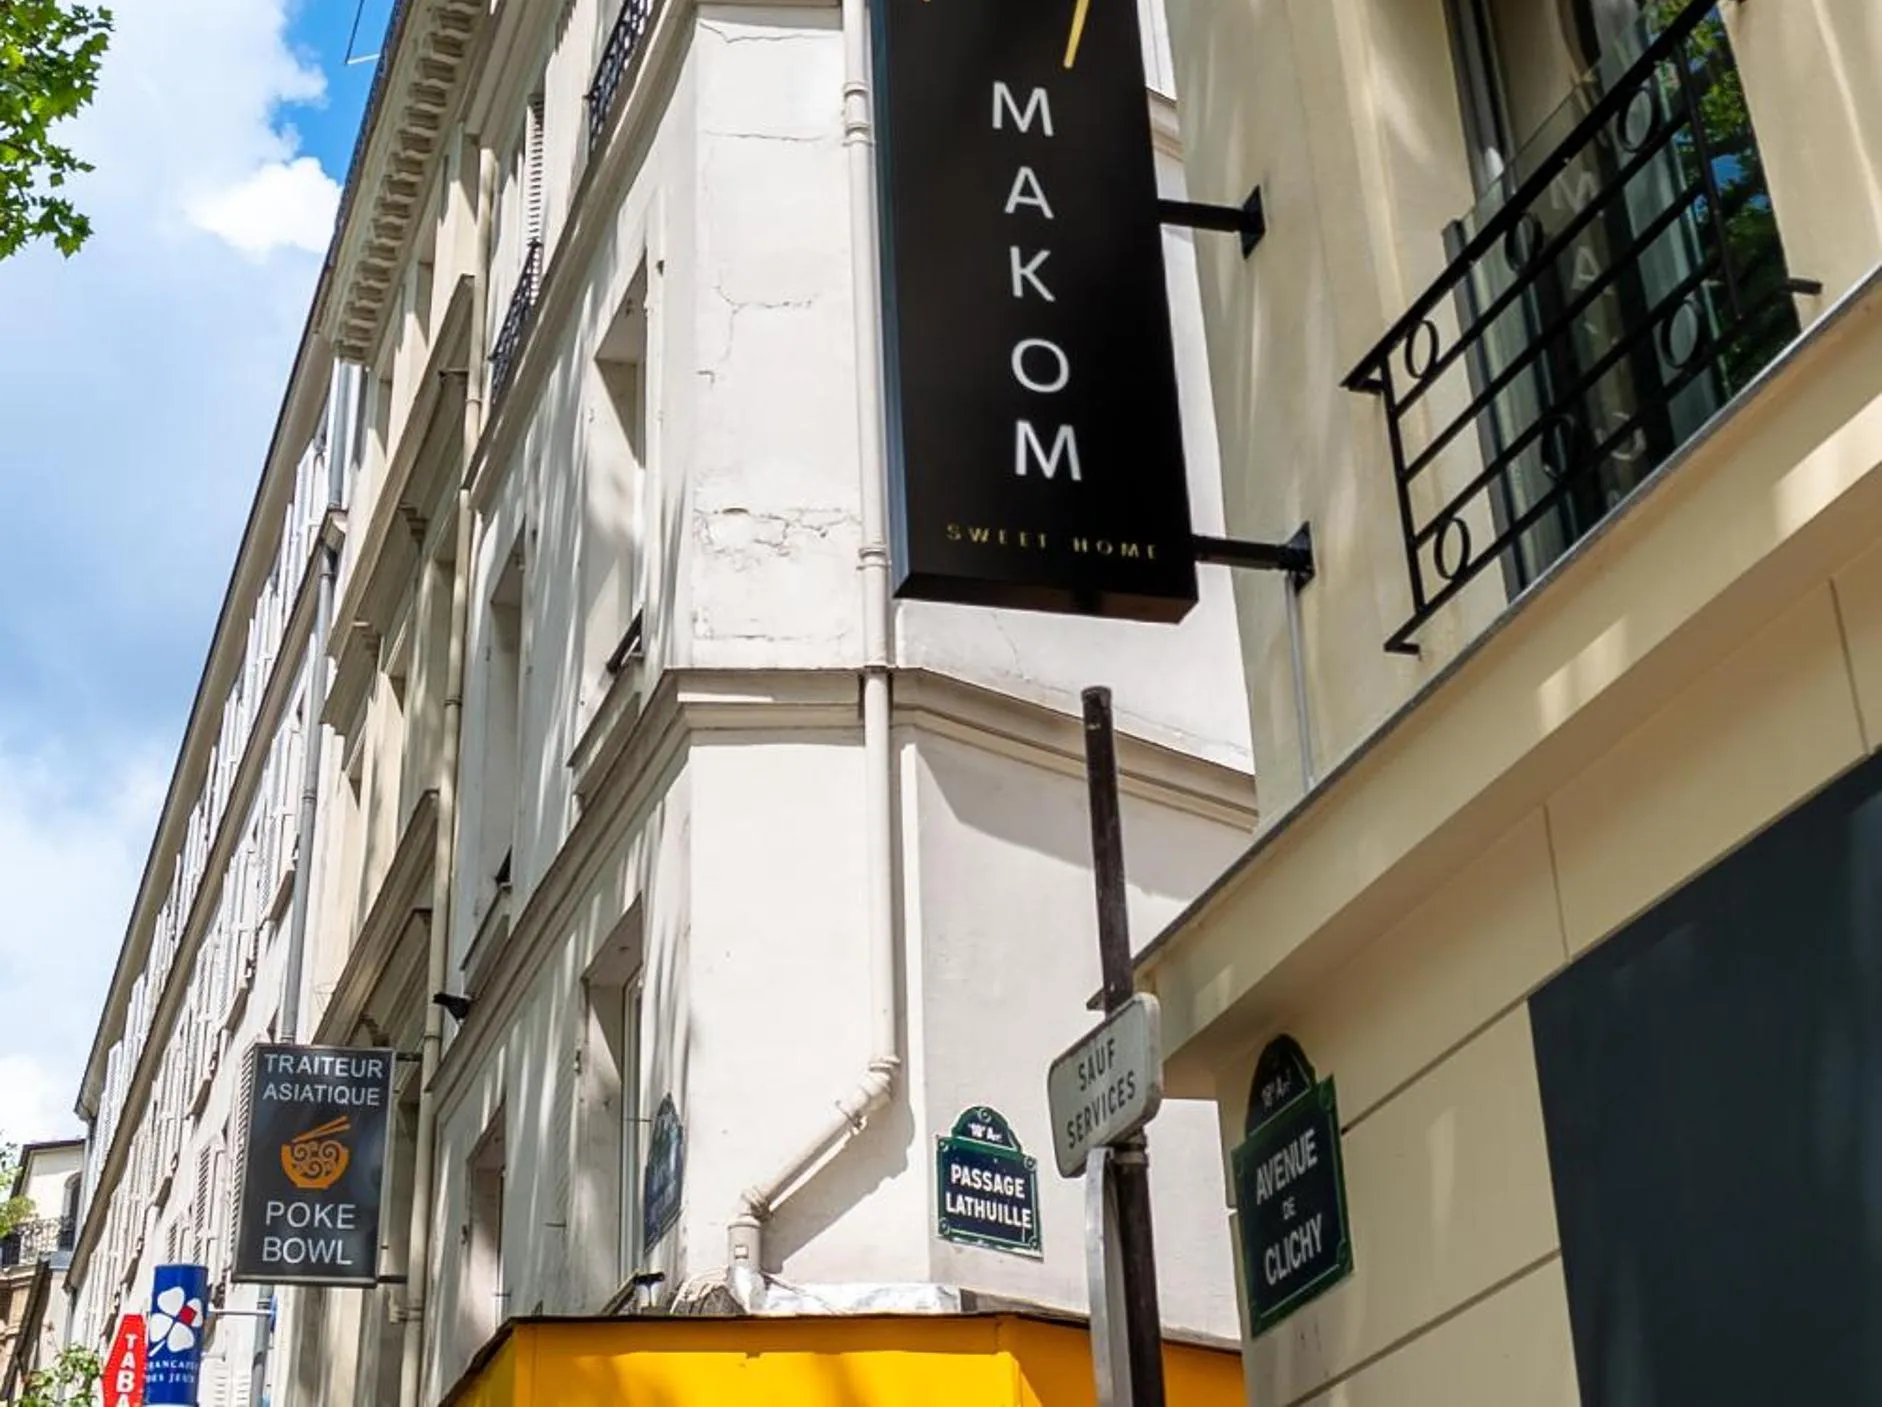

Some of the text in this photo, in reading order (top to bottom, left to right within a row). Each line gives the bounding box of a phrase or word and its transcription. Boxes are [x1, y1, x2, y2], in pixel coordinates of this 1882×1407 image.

[992, 80, 1082, 482] MAKOM
[946, 523, 1157, 560] SWEET HOME
[264, 1053, 383, 1079] TRAITEUR
[1078, 1038, 1116, 1092] SAUF
[262, 1082, 381, 1107] ASIATIQUE
[1066, 1070, 1136, 1149] SERVICES
[950, 1163, 1025, 1200] PASSAGE
[1255, 1128, 1319, 1206] AVENUE
[265, 1200, 356, 1230] POKE
[945, 1192, 1032, 1229] LATHUILLE
[1282, 1196, 1296, 1221] DE
[261, 1236, 354, 1266] BOWL
[1265, 1213, 1323, 1286] CLICHY
